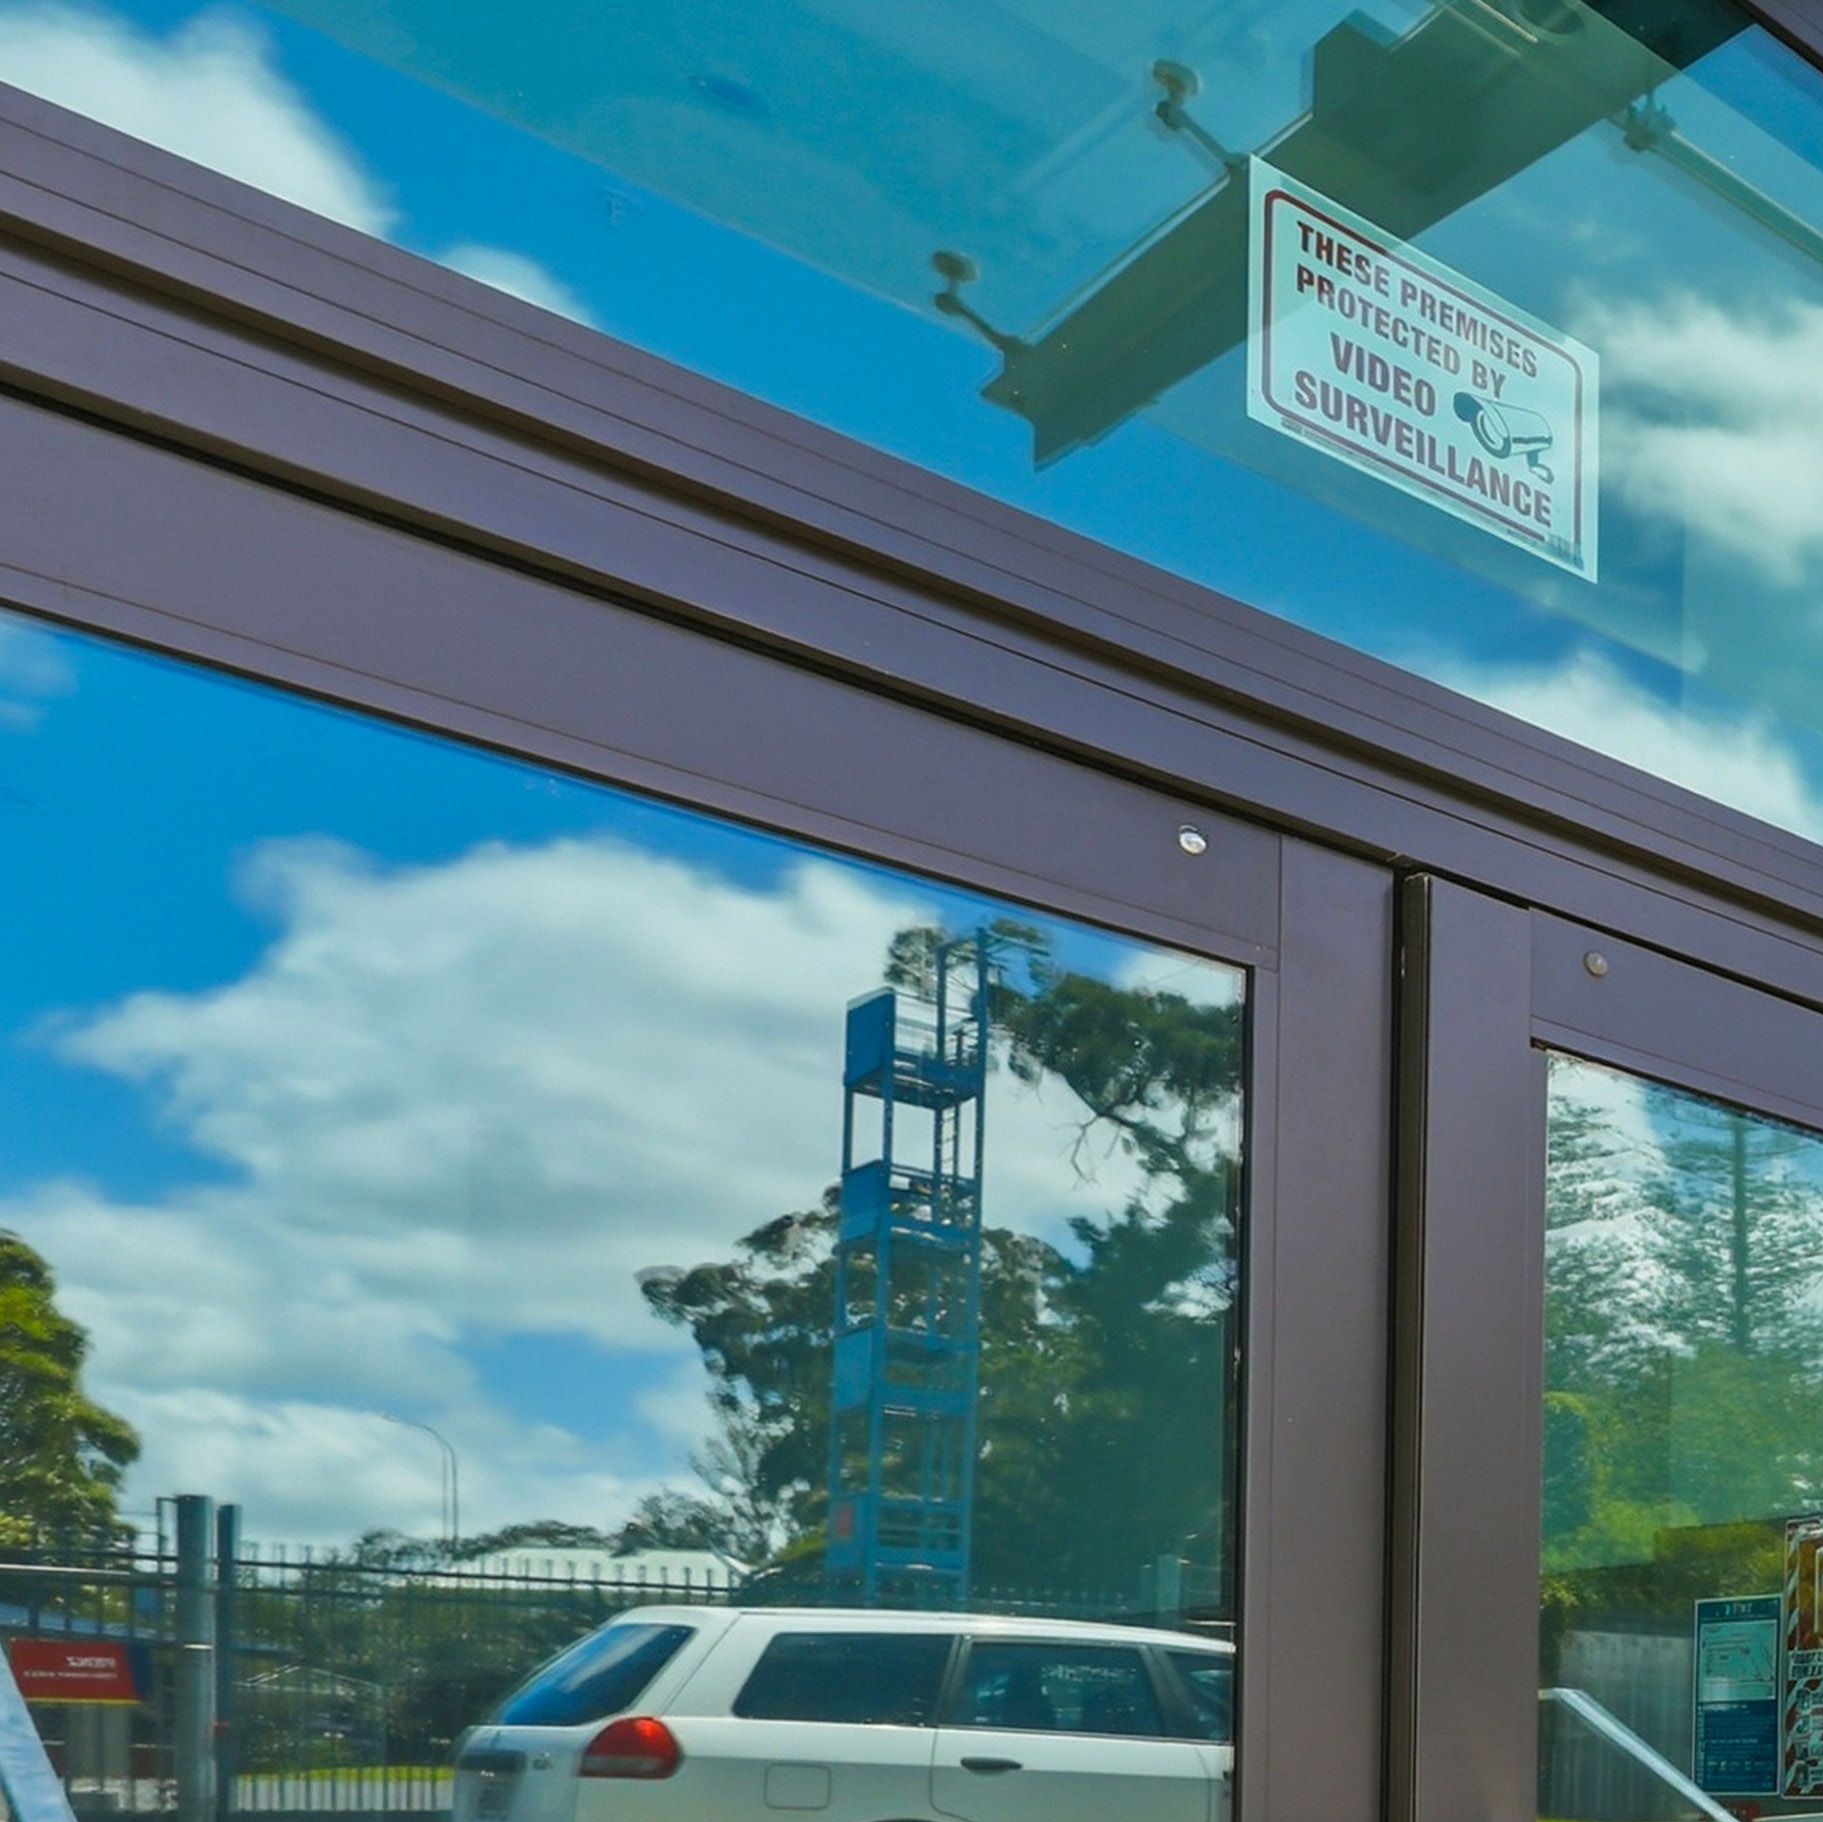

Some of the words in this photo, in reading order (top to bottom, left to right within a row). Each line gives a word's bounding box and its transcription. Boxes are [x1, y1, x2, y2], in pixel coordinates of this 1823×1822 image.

[1296, 219, 1390, 298] THESE
[1400, 273, 1538, 379] PREMISES
[1296, 263, 1461, 376] PROTECTED
[1471, 359, 1506, 399] BY
[1330, 330, 1436, 418] VIDEO
[1294, 369, 1553, 529] SURVEILLANCE
